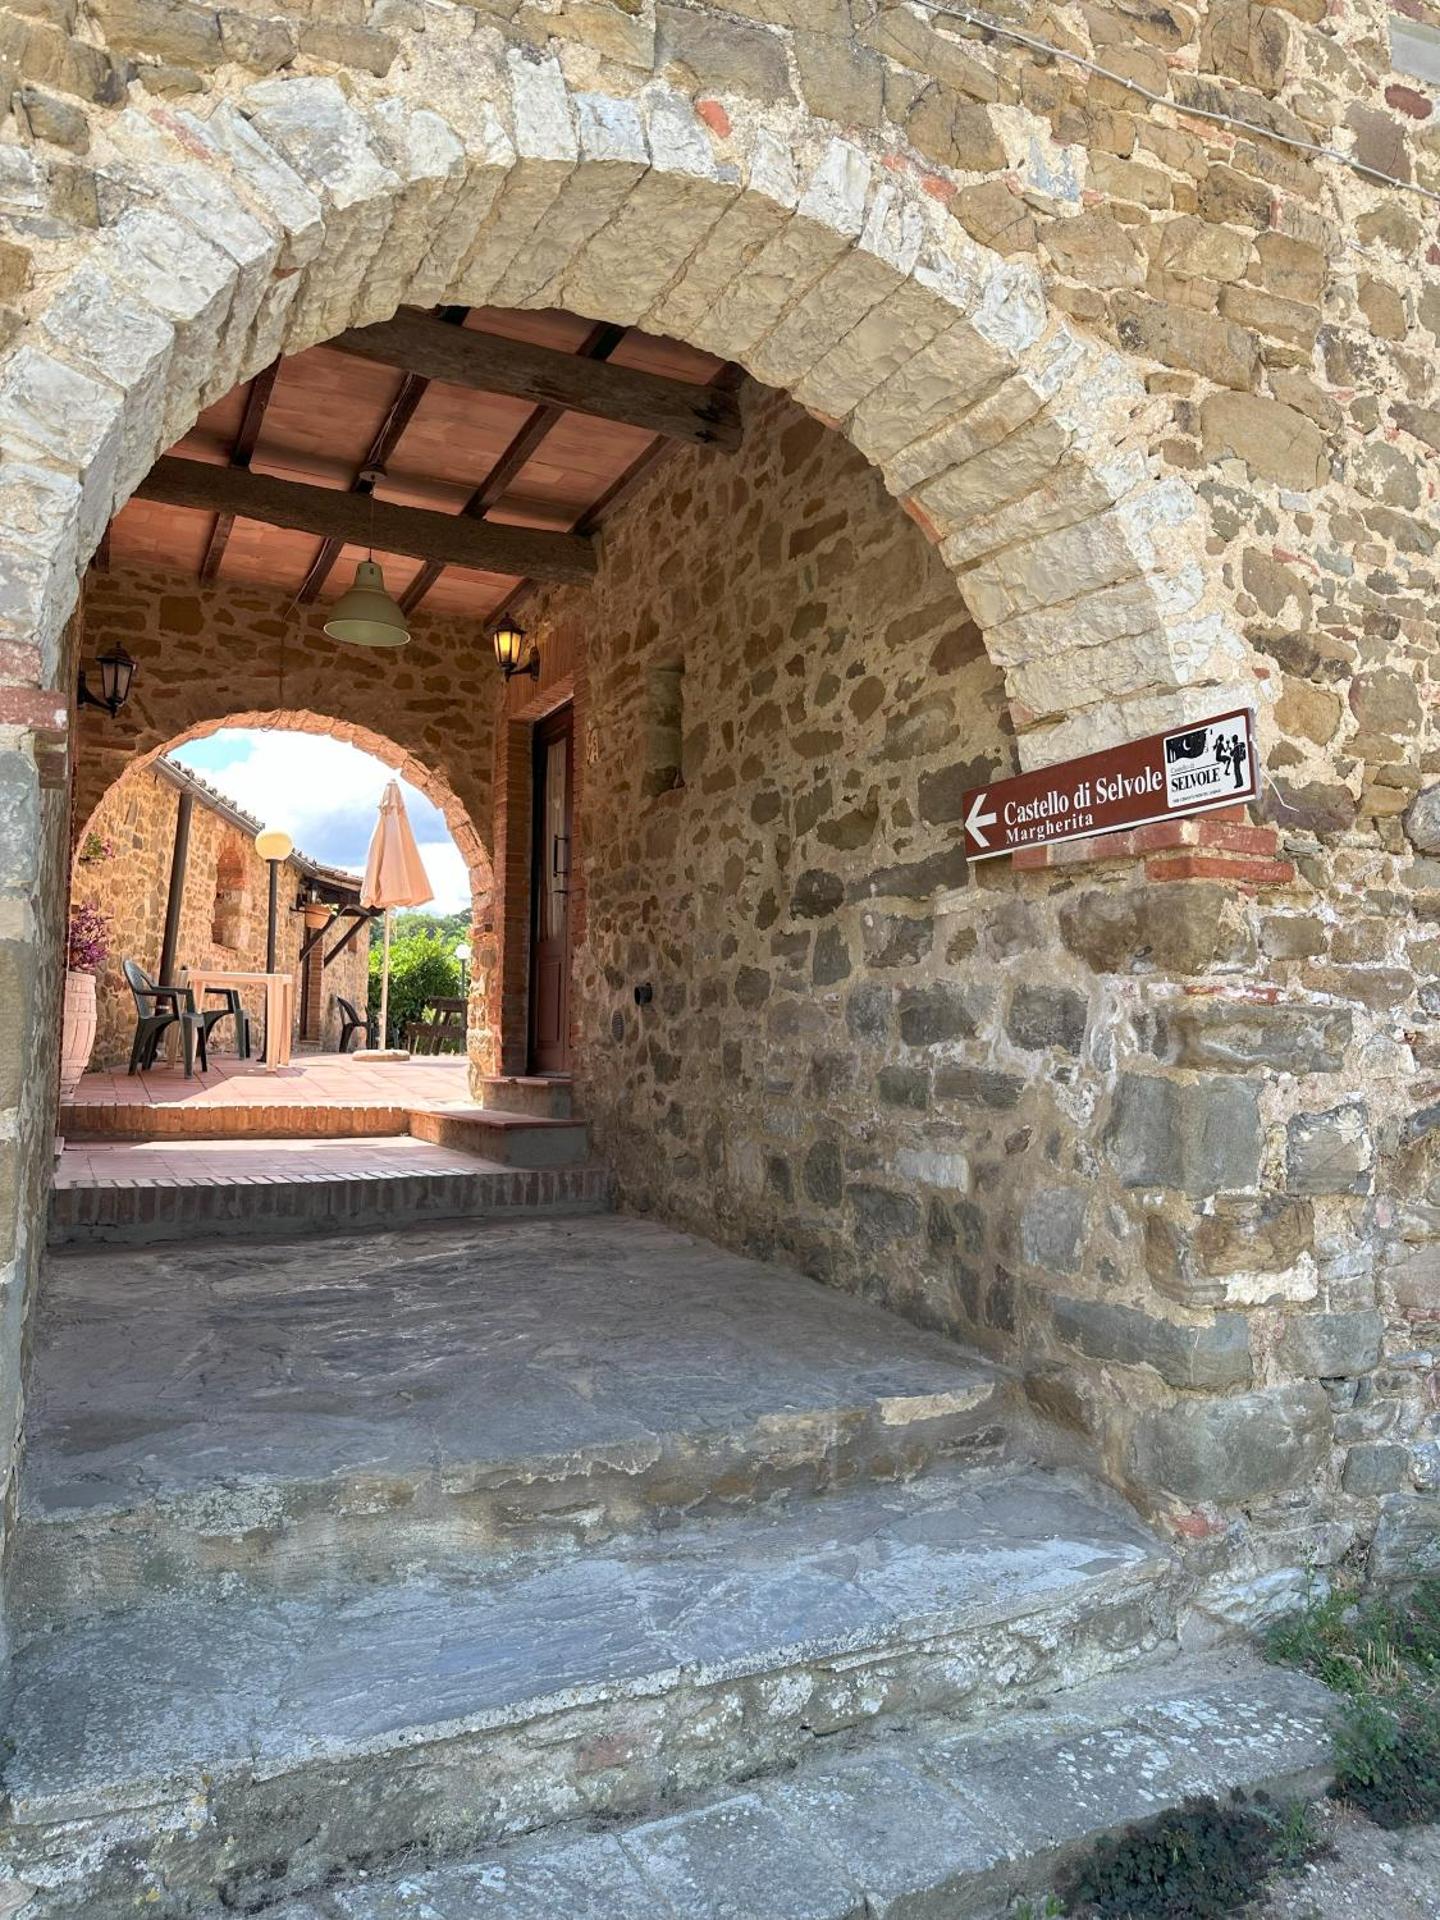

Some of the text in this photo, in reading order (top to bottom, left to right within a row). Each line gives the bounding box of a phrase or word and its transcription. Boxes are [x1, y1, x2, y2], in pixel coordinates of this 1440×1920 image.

[1004, 767, 1163, 826] Castello di Selvole
[1171, 767, 1221, 793] SELVOLE
[1005, 811, 1094, 845] Margherita
